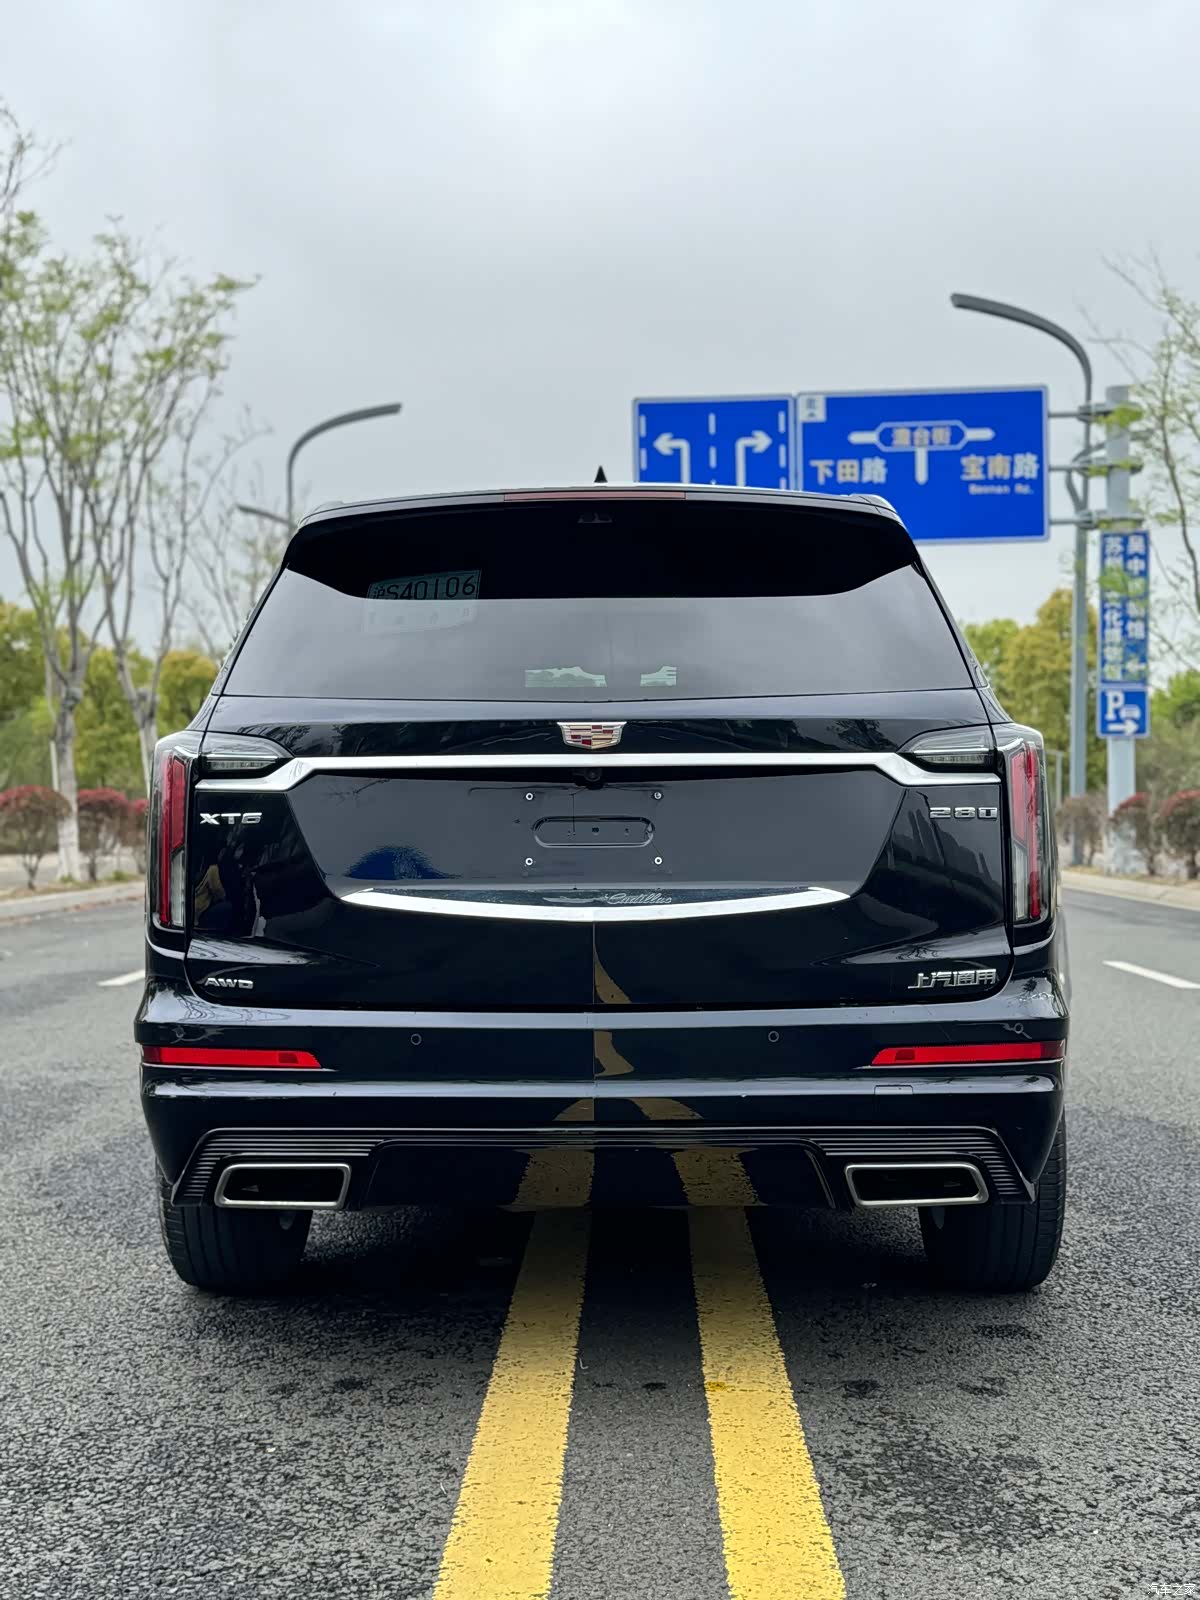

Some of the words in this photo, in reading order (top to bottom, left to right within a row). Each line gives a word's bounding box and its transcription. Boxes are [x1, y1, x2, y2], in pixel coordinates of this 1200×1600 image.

[809, 456, 887, 485] 下田路
[960, 452, 1040, 480] 宝南路
[1105, 690, 1124, 721] P
[199, 812, 263, 825] XT6
[604, 892, 673, 905] Cadillac
[203, 977, 254, 989] AWD
[908, 968, 997, 990] 上汽通用
